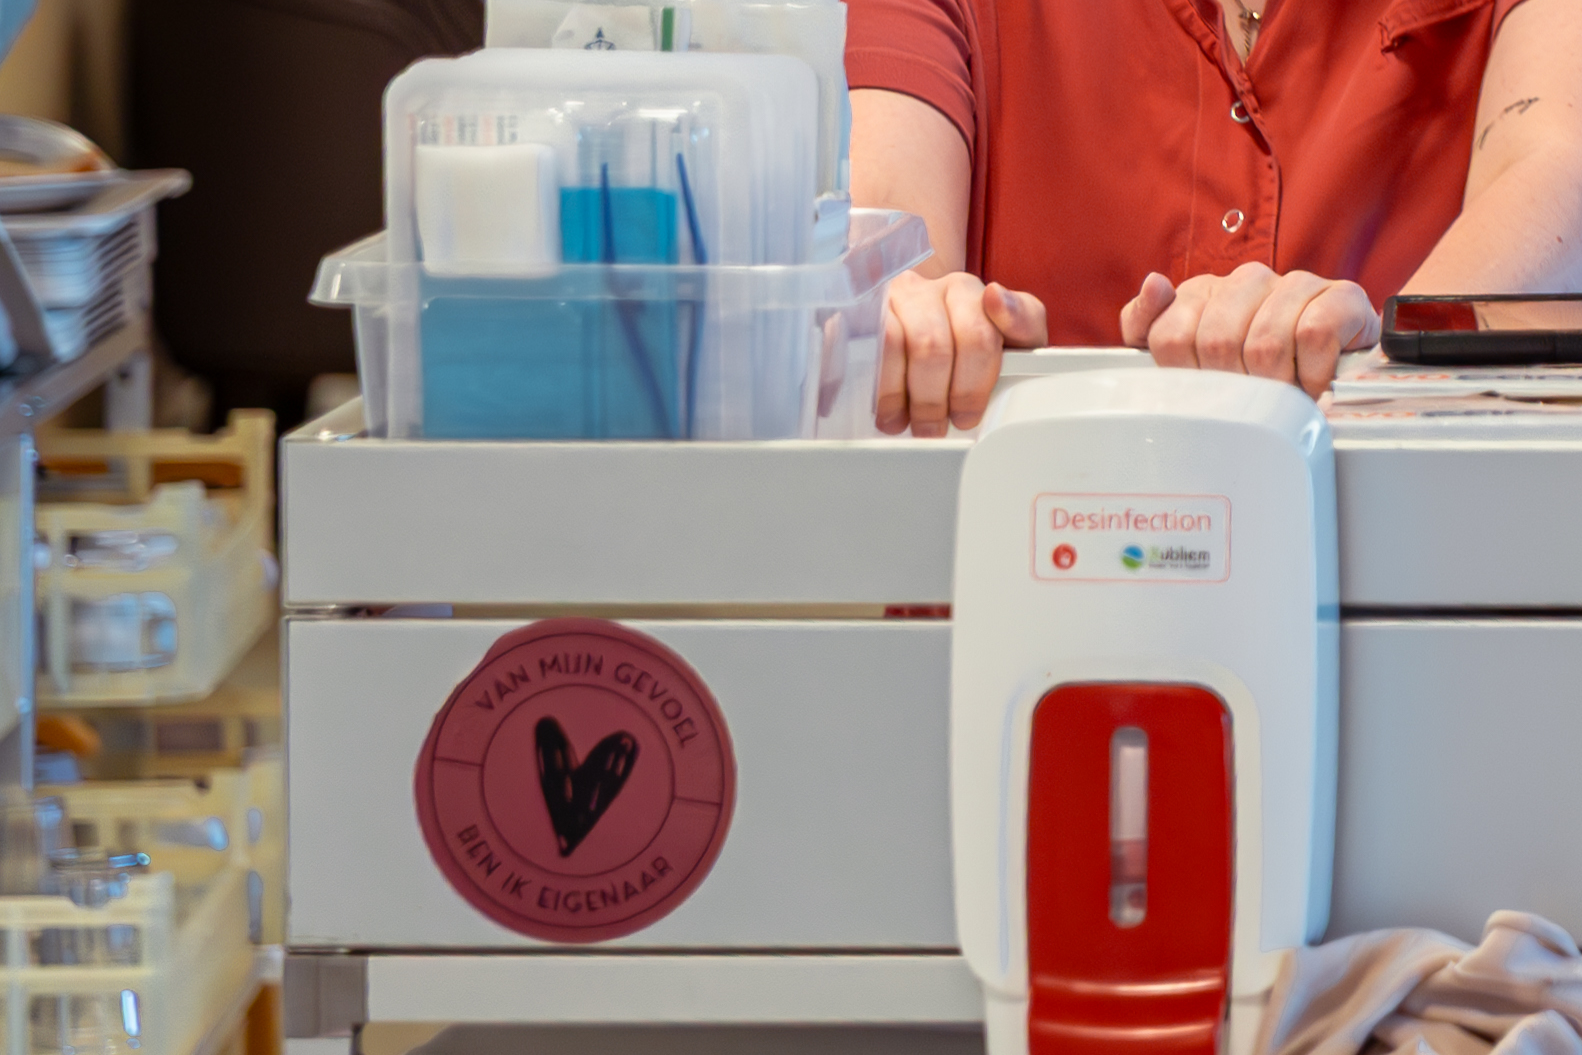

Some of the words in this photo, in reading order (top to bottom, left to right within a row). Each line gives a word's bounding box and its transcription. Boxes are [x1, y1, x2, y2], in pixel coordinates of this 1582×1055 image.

[1051, 507, 1212, 532] Desinfection
[475, 664, 530, 712] VAN
[538, 653, 605, 679] MIJN
[613, 661, 700, 749] GEVOEL
[456, 824, 503, 878] BEN
[502, 871, 533, 901] IK
[536, 855, 675, 914] EIGENAAR
